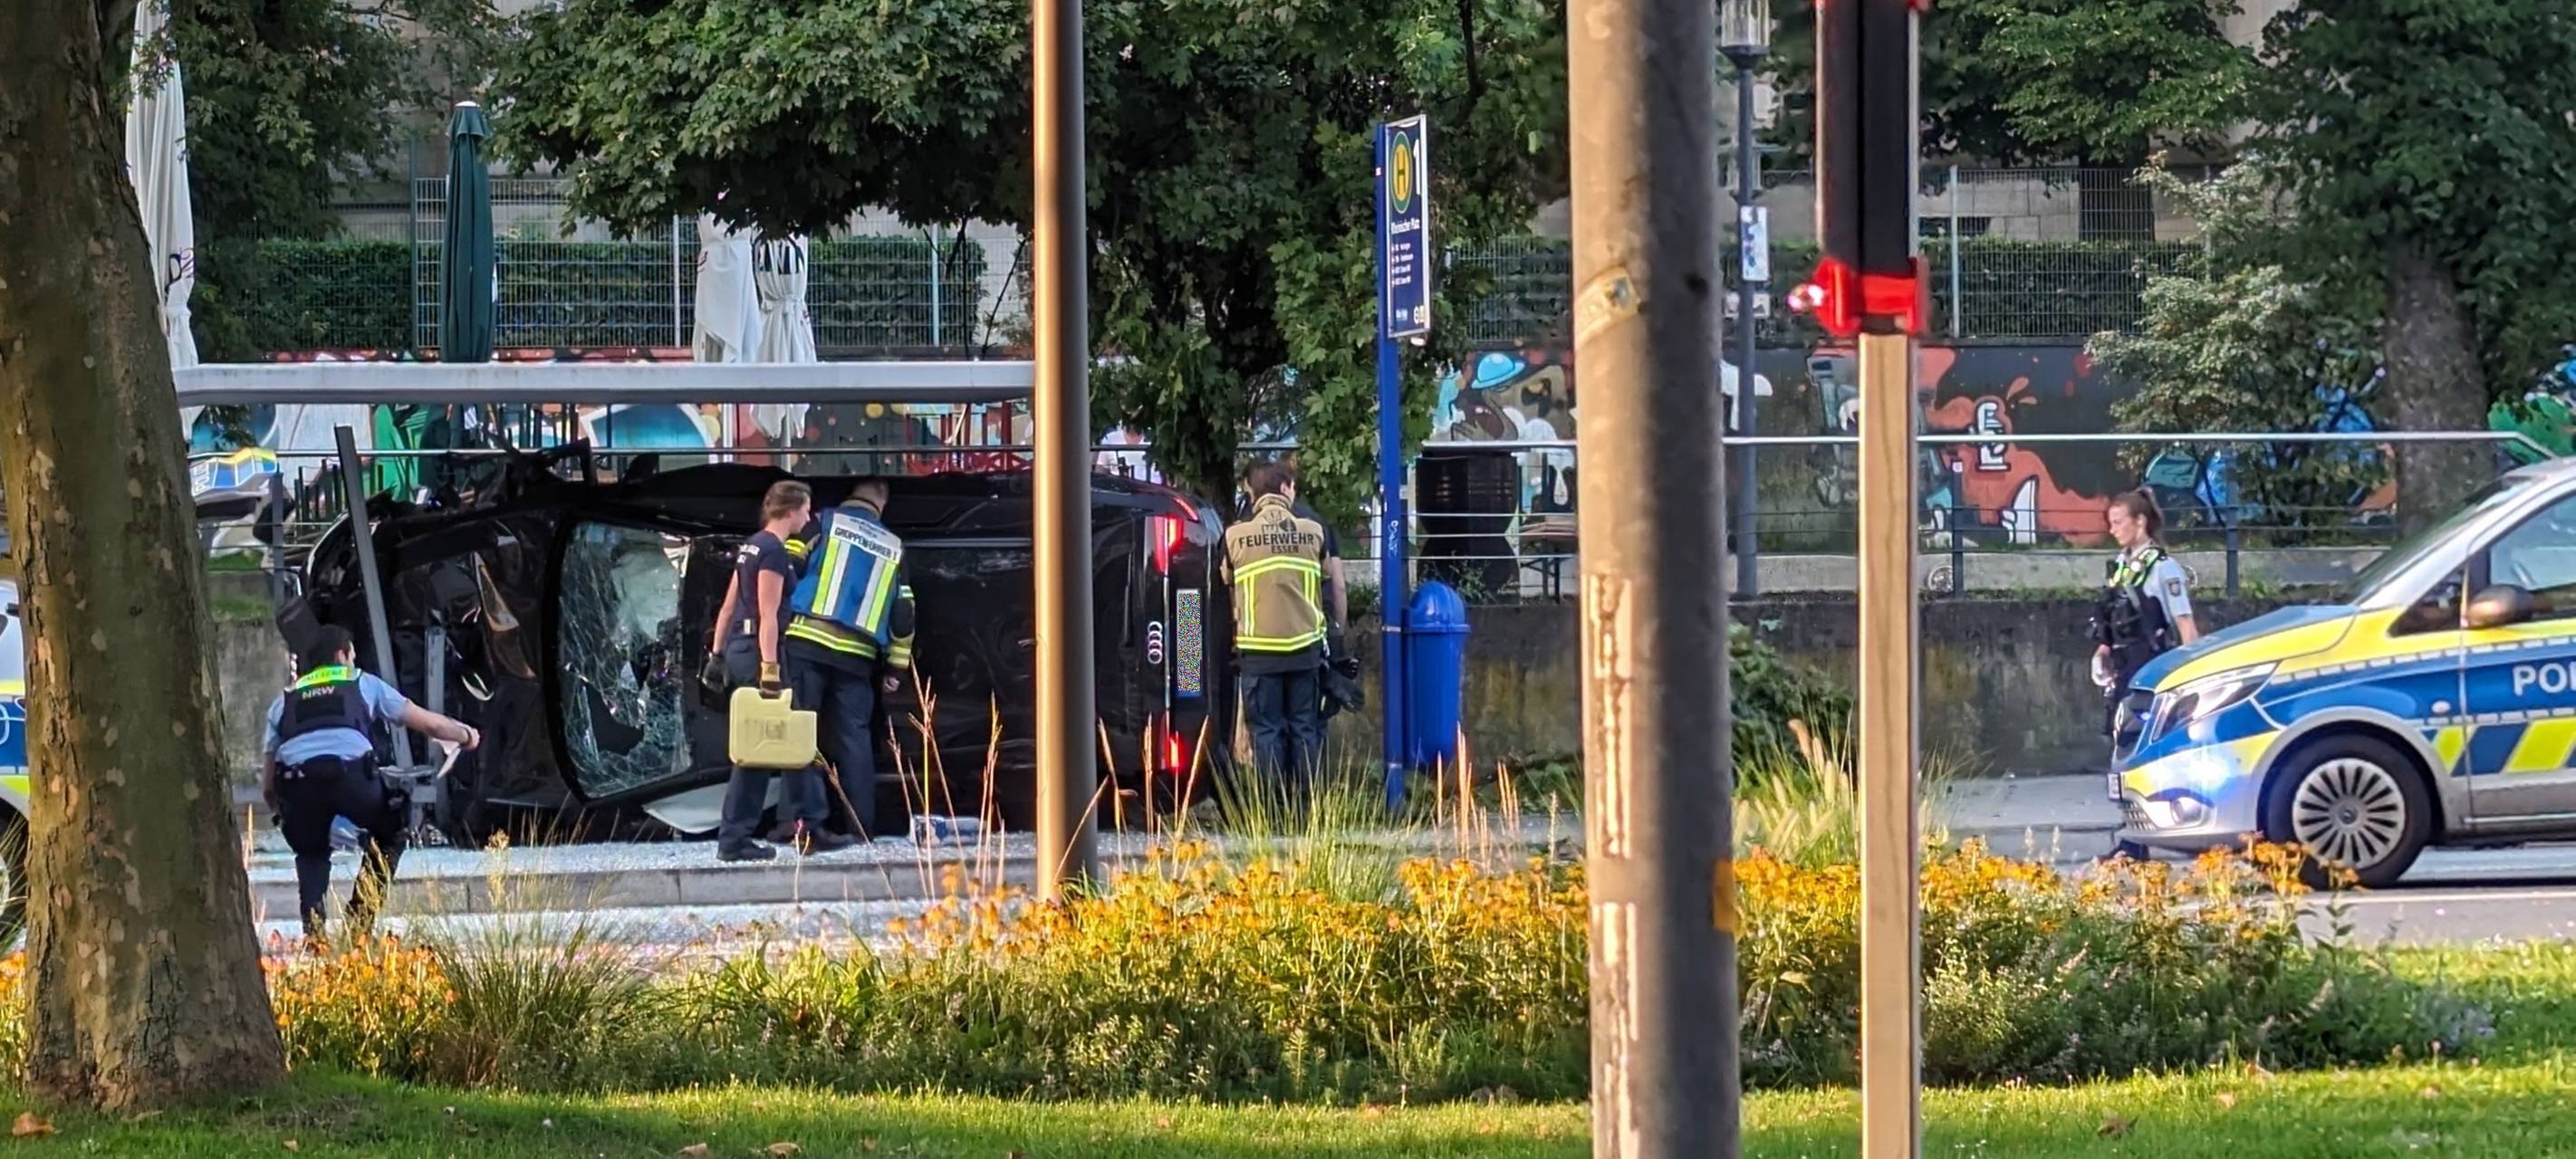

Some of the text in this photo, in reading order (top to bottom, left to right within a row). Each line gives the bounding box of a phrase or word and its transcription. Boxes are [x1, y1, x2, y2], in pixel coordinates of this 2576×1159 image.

[1413, 139, 1421, 196] 1
[1239, 532, 1313, 549] FEUERWEHR
[1271, 545, 1299, 554] ESSEN
[302, 685, 334, 699] NRW
